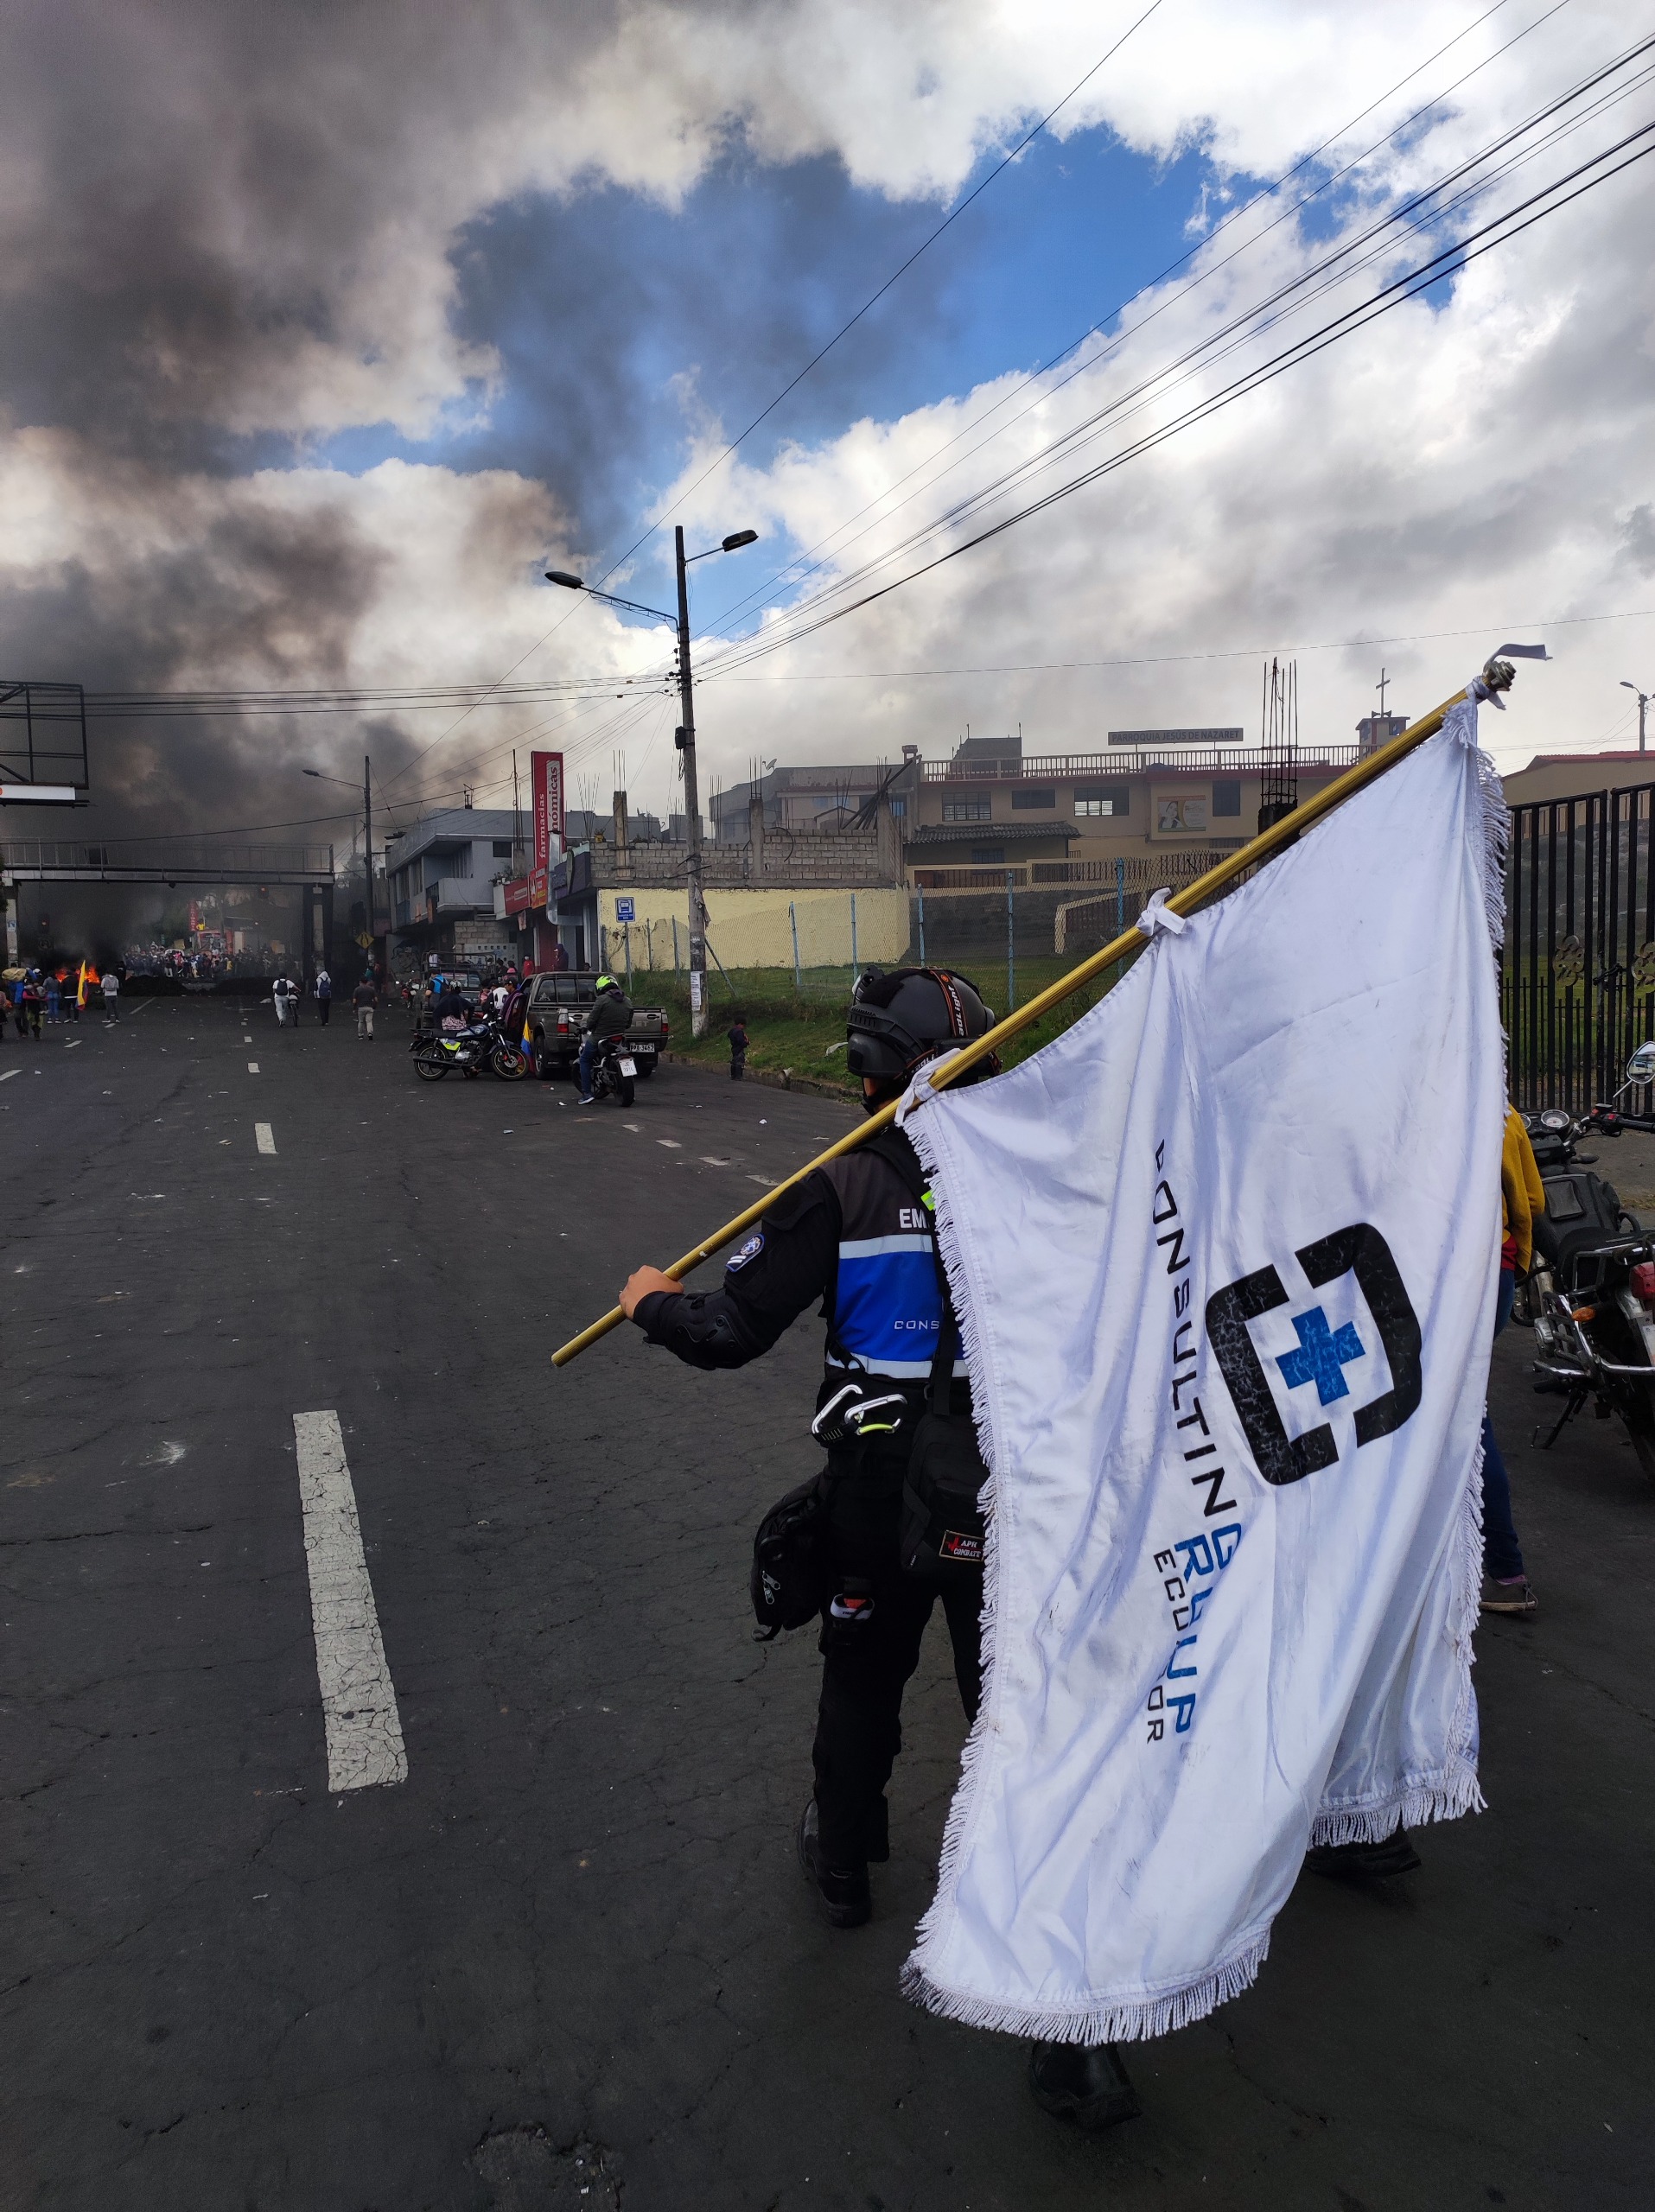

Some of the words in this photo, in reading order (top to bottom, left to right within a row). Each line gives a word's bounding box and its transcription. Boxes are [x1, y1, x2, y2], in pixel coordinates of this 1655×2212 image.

[1111, 732, 1161, 742] PARROQUIA
[1188, 730, 1200, 740] DE
[1200, 729, 1239, 740] NAZARET
[894, 1320, 939, 1330] CONS
